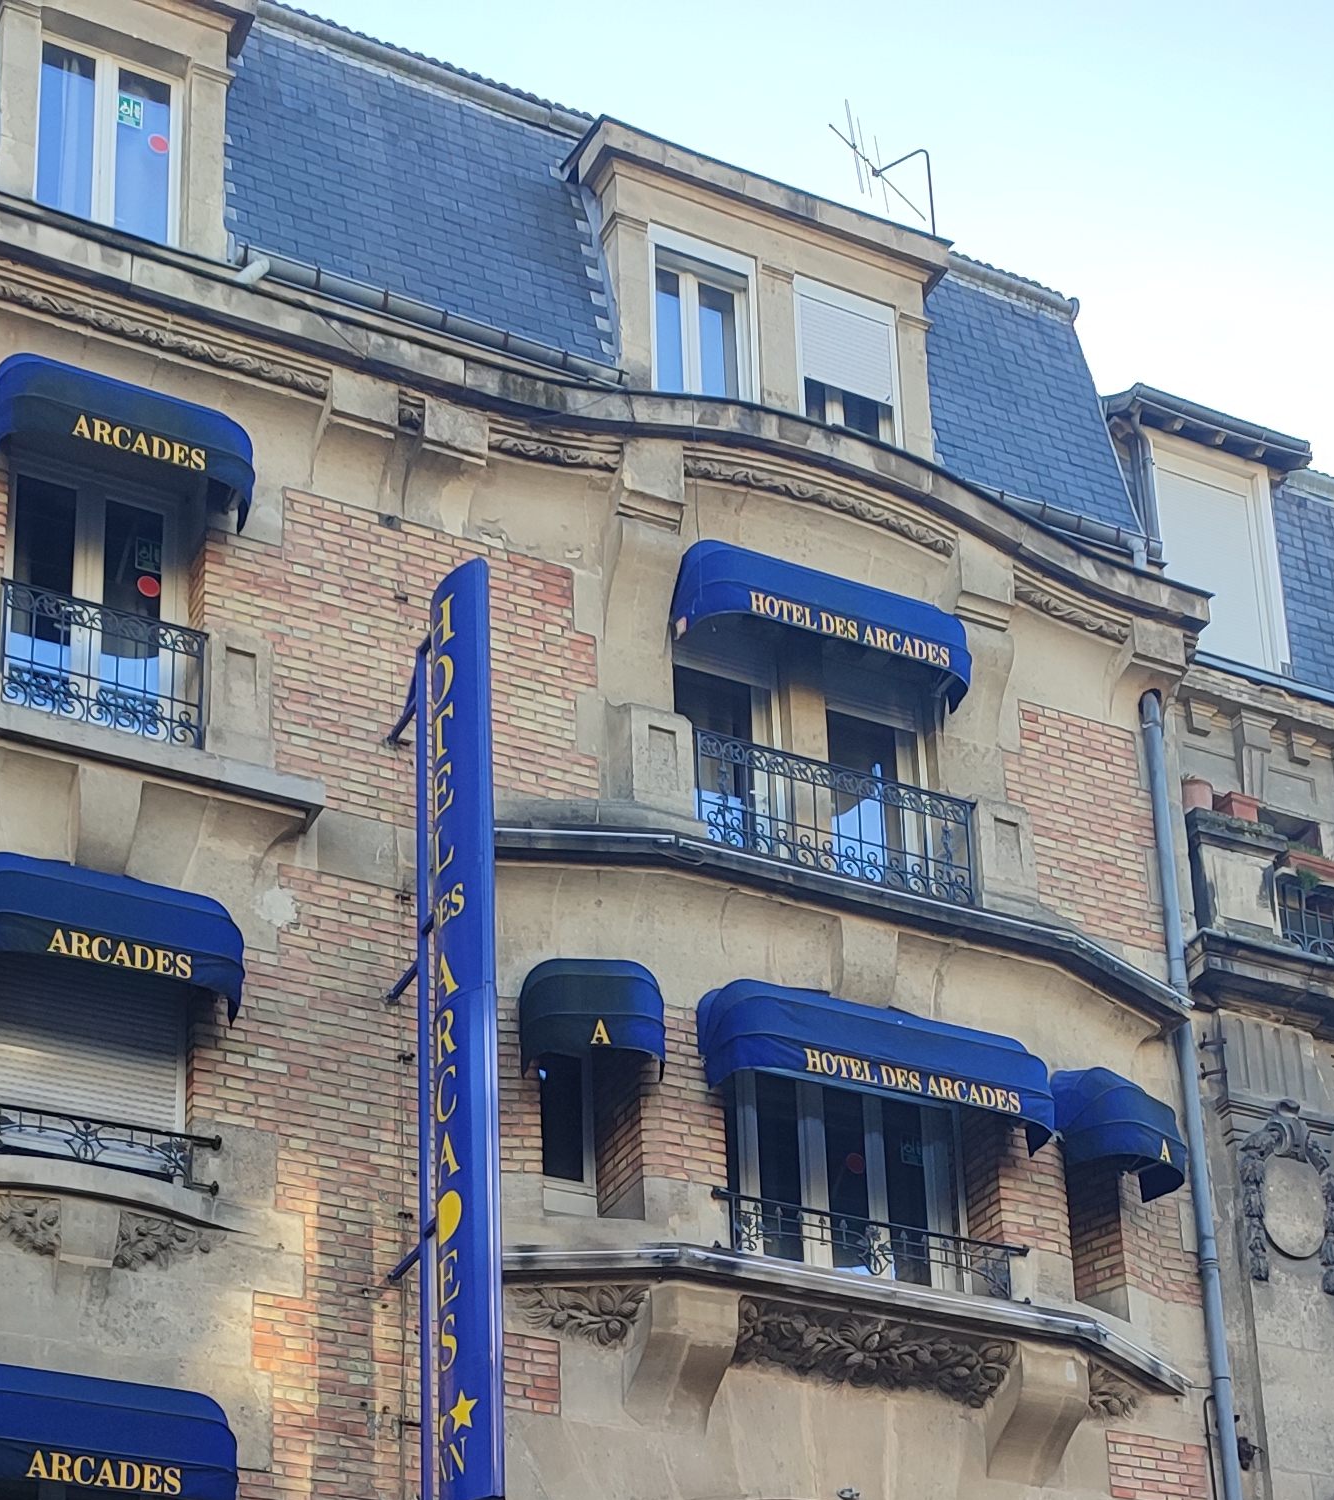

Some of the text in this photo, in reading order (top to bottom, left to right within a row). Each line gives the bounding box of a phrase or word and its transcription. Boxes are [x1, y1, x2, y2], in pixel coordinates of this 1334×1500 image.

[72, 414, 207, 471] ARCADES
[749, 590, 950, 669] HOTEL DES ARCADES
[47, 928, 192, 980] ARCADES
[590, 1018, 612, 1045] A
[803, 1047, 1022, 1114] HOTEL DES ARCADES
[1159, 1138, 1173, 1164] A
[26, 1449, 182, 1495] ARCADES
